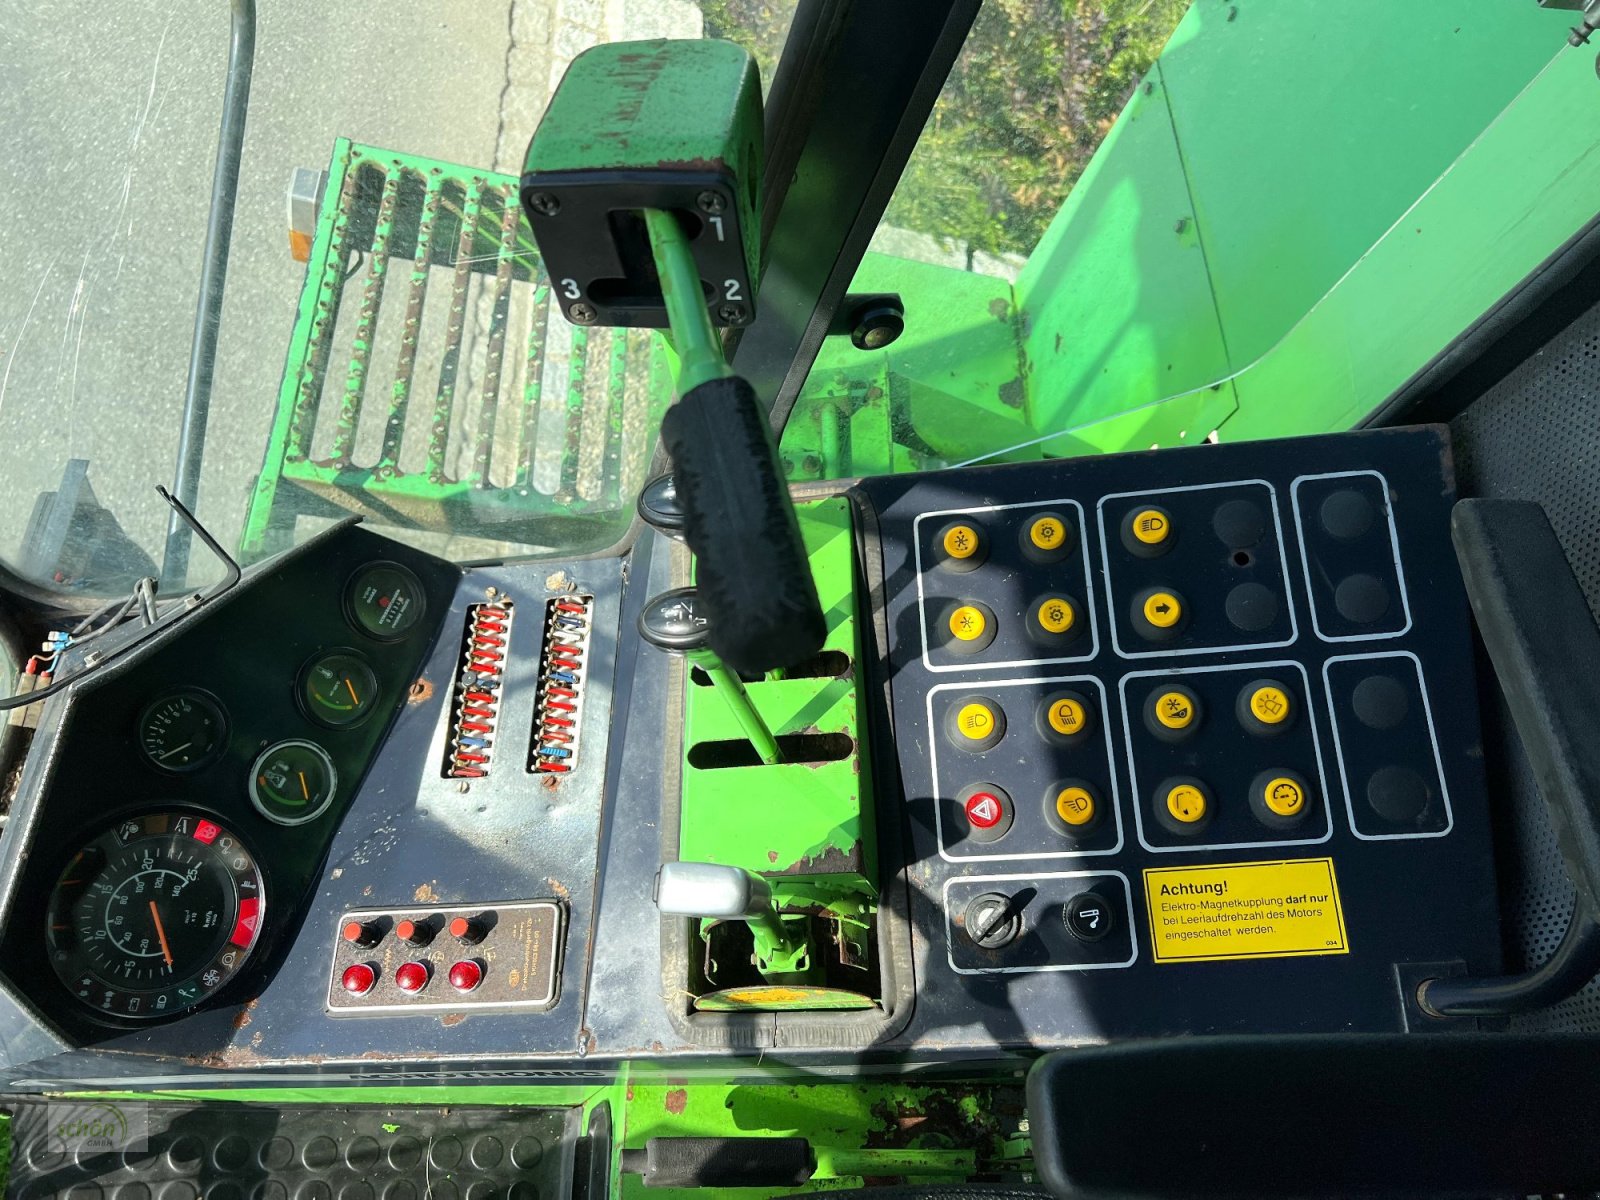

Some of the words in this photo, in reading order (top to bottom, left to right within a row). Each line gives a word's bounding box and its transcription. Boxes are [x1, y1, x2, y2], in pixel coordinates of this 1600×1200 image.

[709, 216, 725, 242] 1
[561, 278, 581, 300] 3
[724, 279, 742, 301] 2
[142, 858, 154, 871] 20
[186, 868, 198, 882] 25
[102, 884, 113, 894] 15
[136, 882, 145, 893] 100
[154, 876, 164, 889] 120
[1160, 880, 1228, 896] Achtung!
[172, 885, 182, 897] 140
[120, 895, 128, 905] 80
[1161, 898, 1284, 912] Elektro-Magnetkupplung
[1286, 895, 1308, 904] darf
[1310, 894, 1328, 903] nur
[114, 916, 124, 926] 60
[1163, 916, 1179, 926] bei
[1181, 910, 1264, 924] Leerlaufdrehzahl
[1266, 909, 1285, 919] des
[1287, 908, 1323, 918] Motors
[96, 930, 107, 940] 10
[123, 932, 132, 942] 40
[1165, 928, 1232, 942] eingeschaltet
[1236, 924, 1276, 934] werden.
[140, 938, 150, 950] 20
[125, 960, 136, 971] 5
